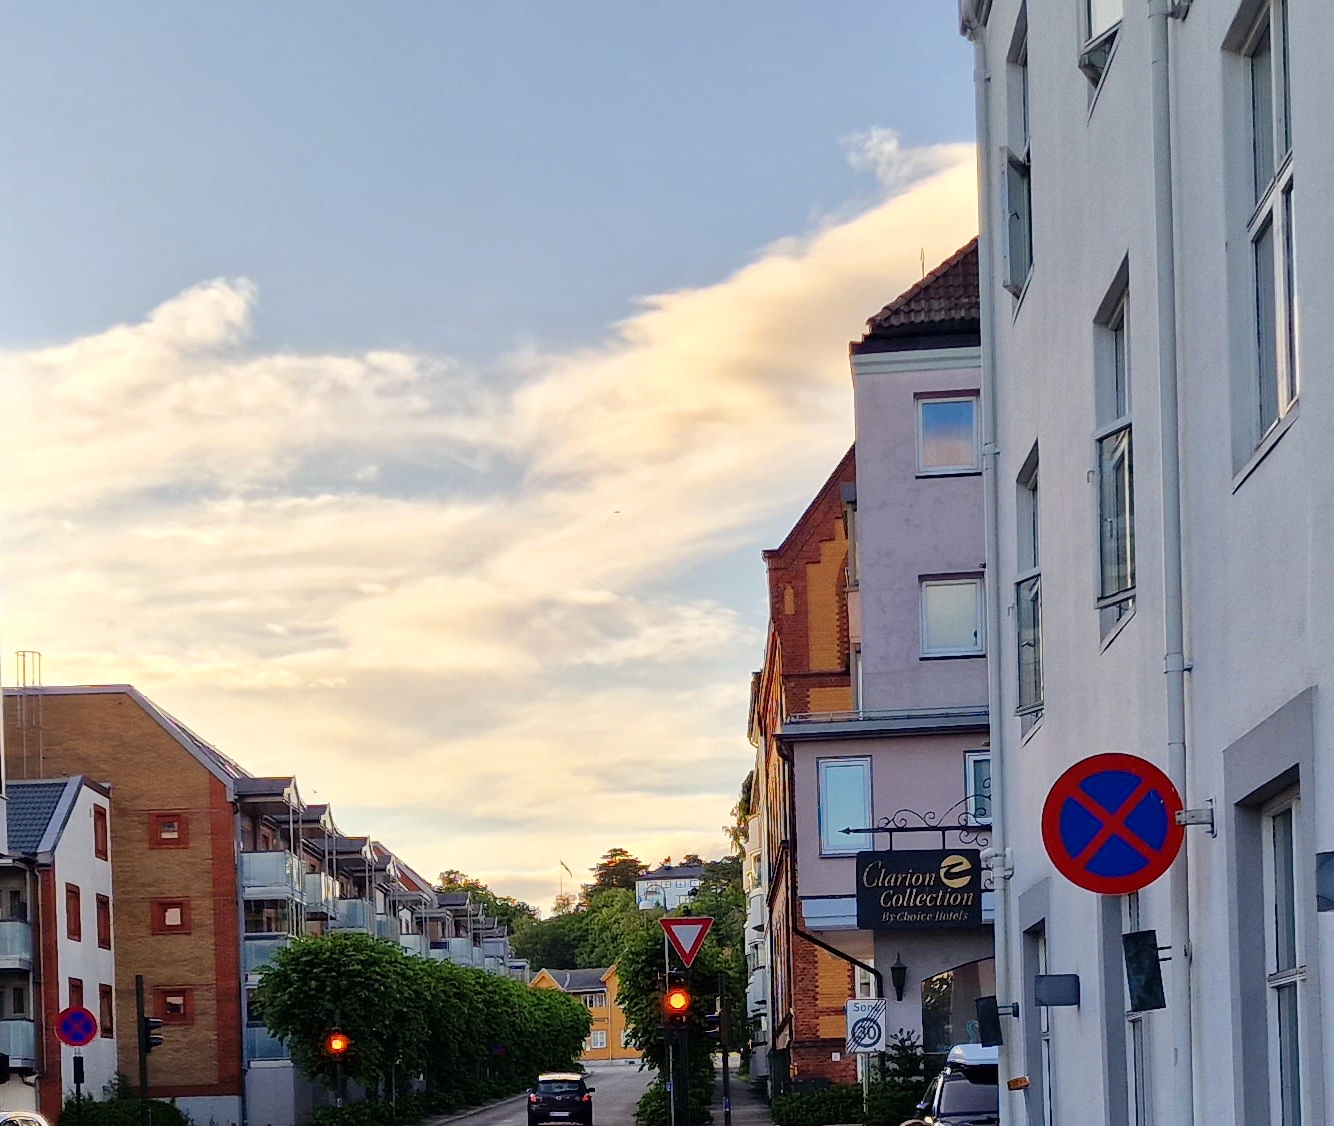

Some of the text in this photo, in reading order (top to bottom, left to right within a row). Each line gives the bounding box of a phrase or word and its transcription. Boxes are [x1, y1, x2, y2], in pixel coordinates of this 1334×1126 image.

[863, 861, 935, 888] Clarion
[880, 888, 973, 907] Collection
[895, 911, 932, 921] Choice
[853, 1003, 879, 1011] Son
